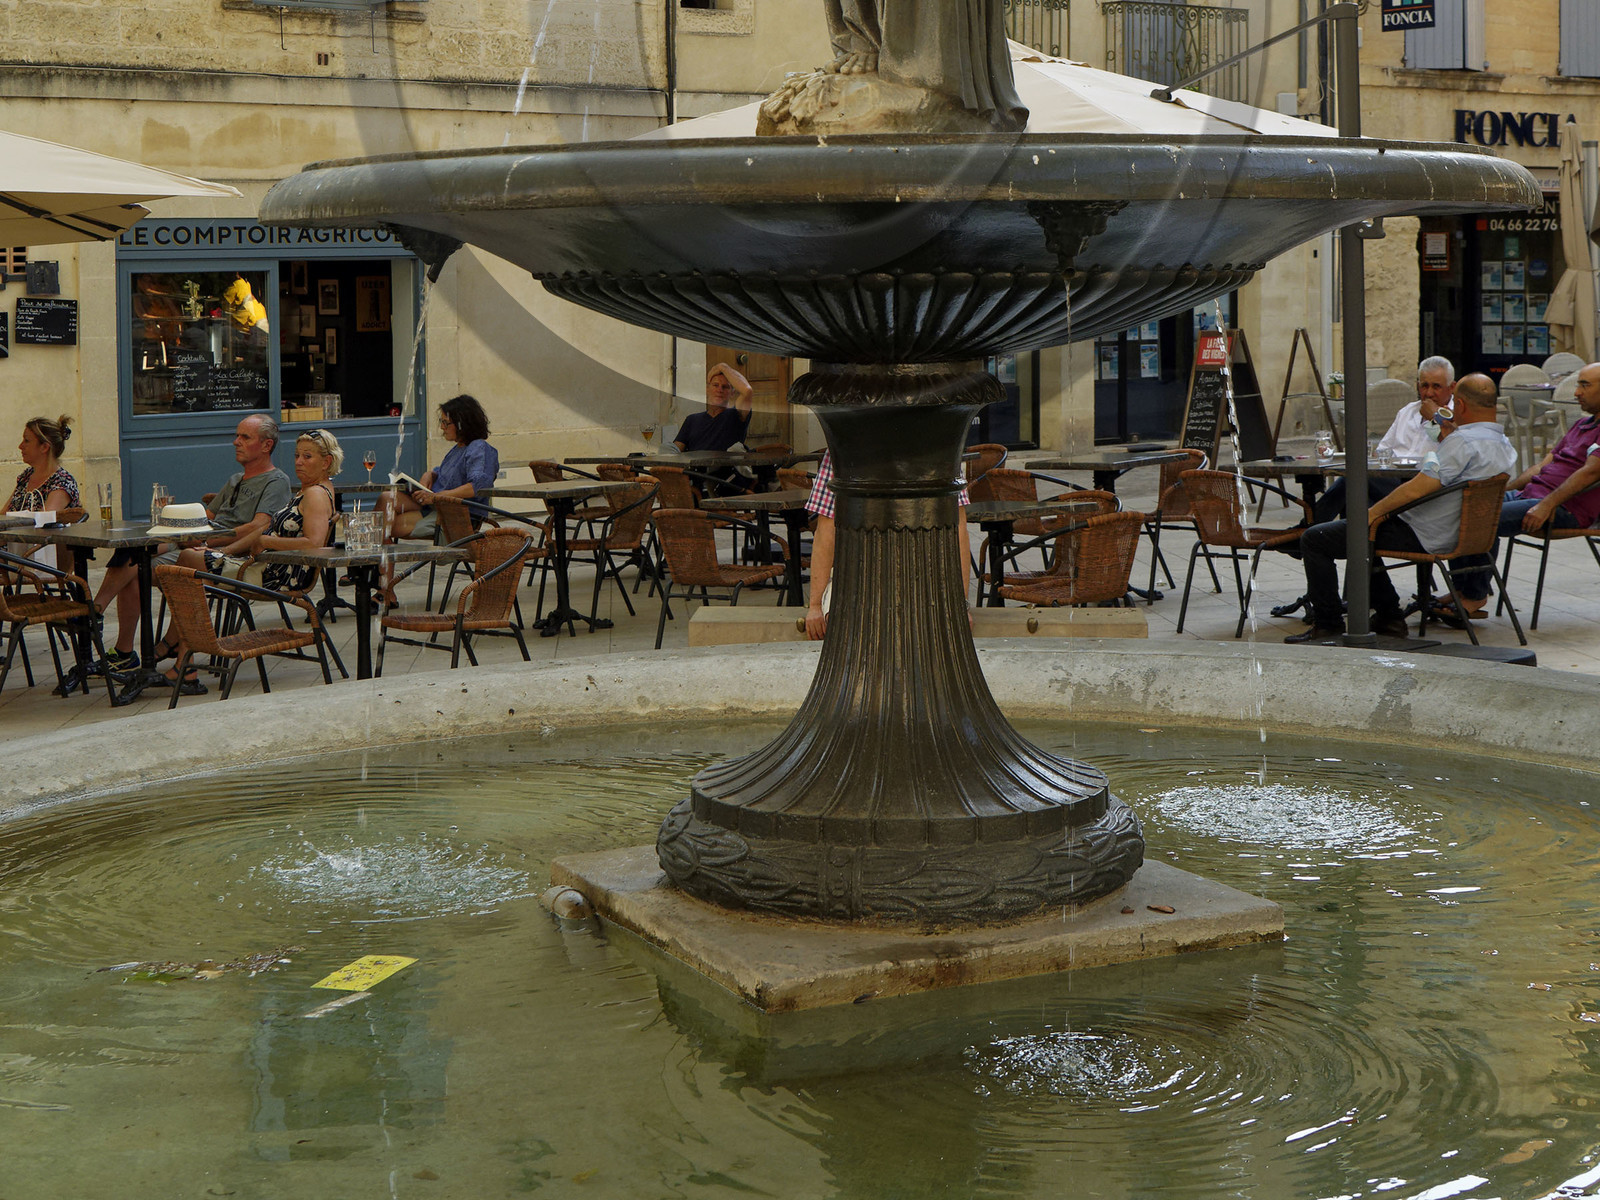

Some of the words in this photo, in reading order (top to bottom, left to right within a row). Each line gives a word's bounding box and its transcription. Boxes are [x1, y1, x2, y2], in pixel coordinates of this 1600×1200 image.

[1384, 10, 1433, 26] FONCIA
[1455, 109, 1576, 147] FONCI
[1490, 220, 1506, 230] 04
[1508, 220, 1523, 230] 66
[1525, 220, 1540, 230] 22
[1541, 219, 1558, 230] 76
[119, 226, 148, 246] LE
[153, 225, 291, 246] COMPTOIR
